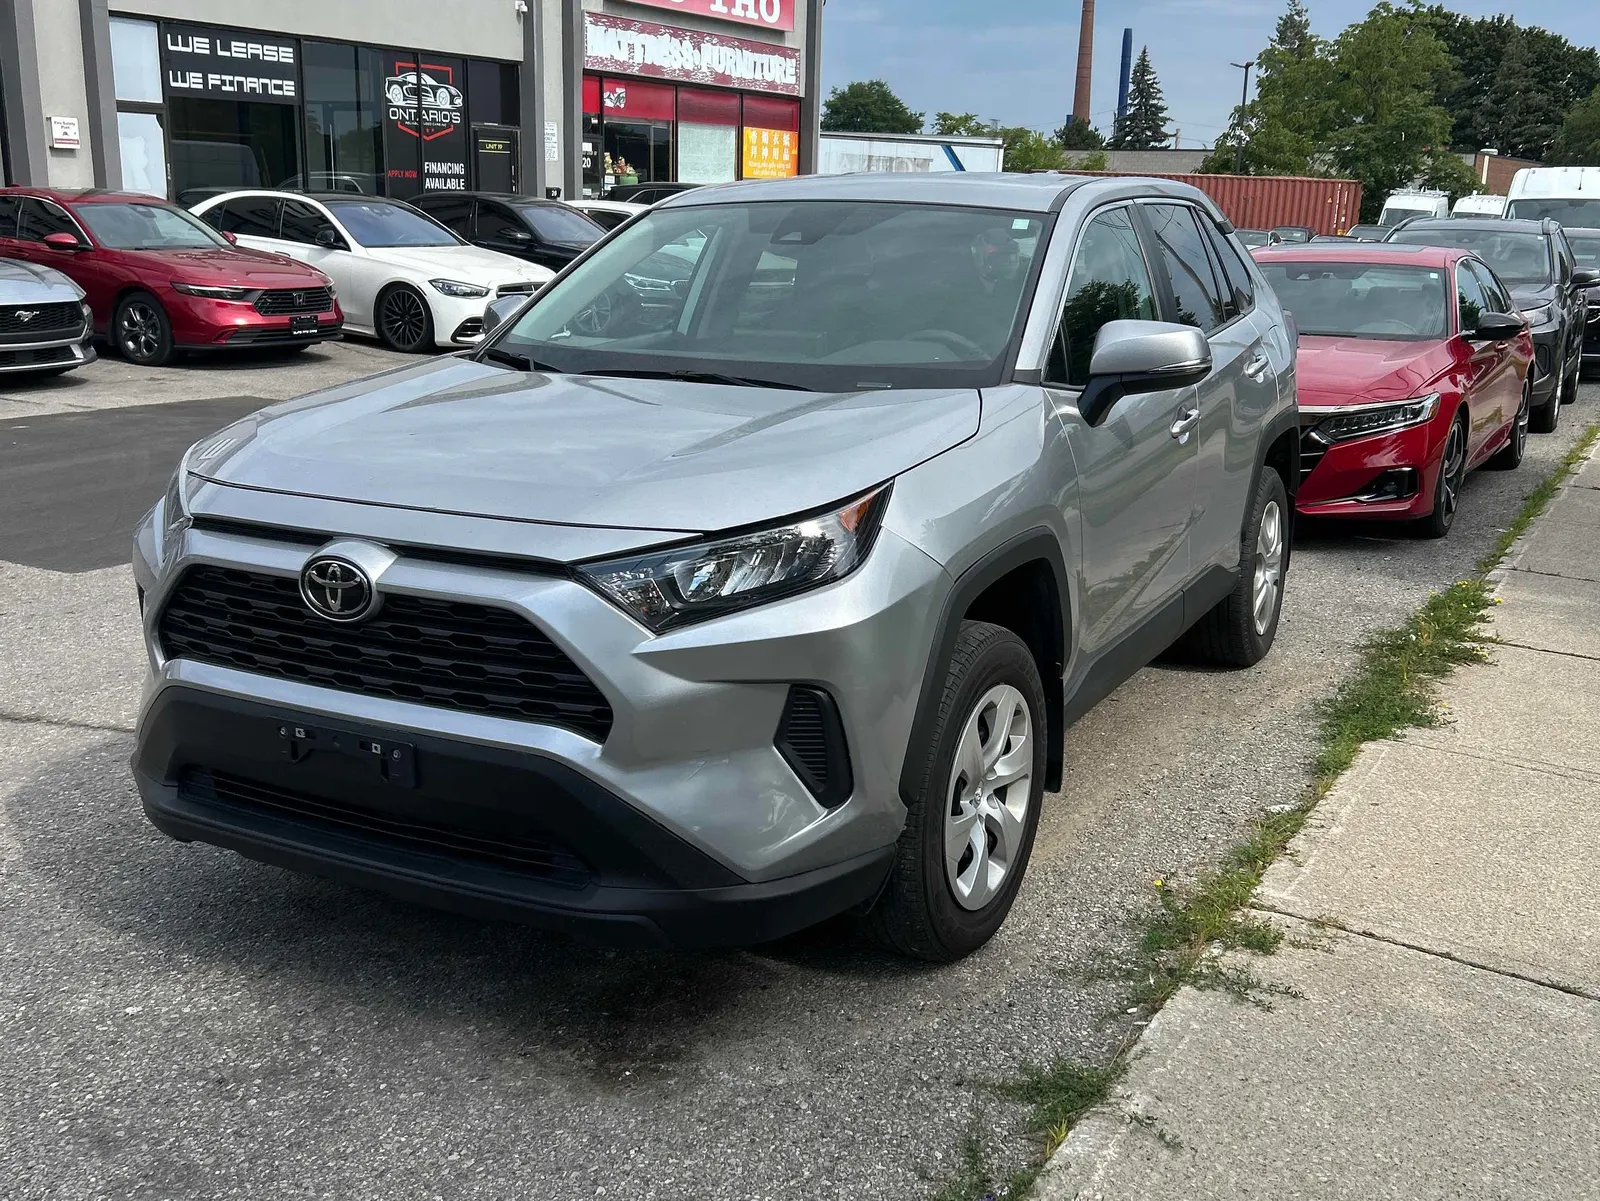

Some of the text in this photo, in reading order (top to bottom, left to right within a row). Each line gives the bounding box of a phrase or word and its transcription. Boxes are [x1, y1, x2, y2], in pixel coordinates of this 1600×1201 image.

[167, 33, 294, 63] WE LEASE
[700, 43, 796, 84] FURNITURE
[169, 70, 296, 97] WE FINANCE
[424, 162, 465, 175] FINANCING
[582, 158, 592, 169] 20
[387, 170, 418, 178] APPLY NOW
[425, 178, 465, 190] AVAILABLE
